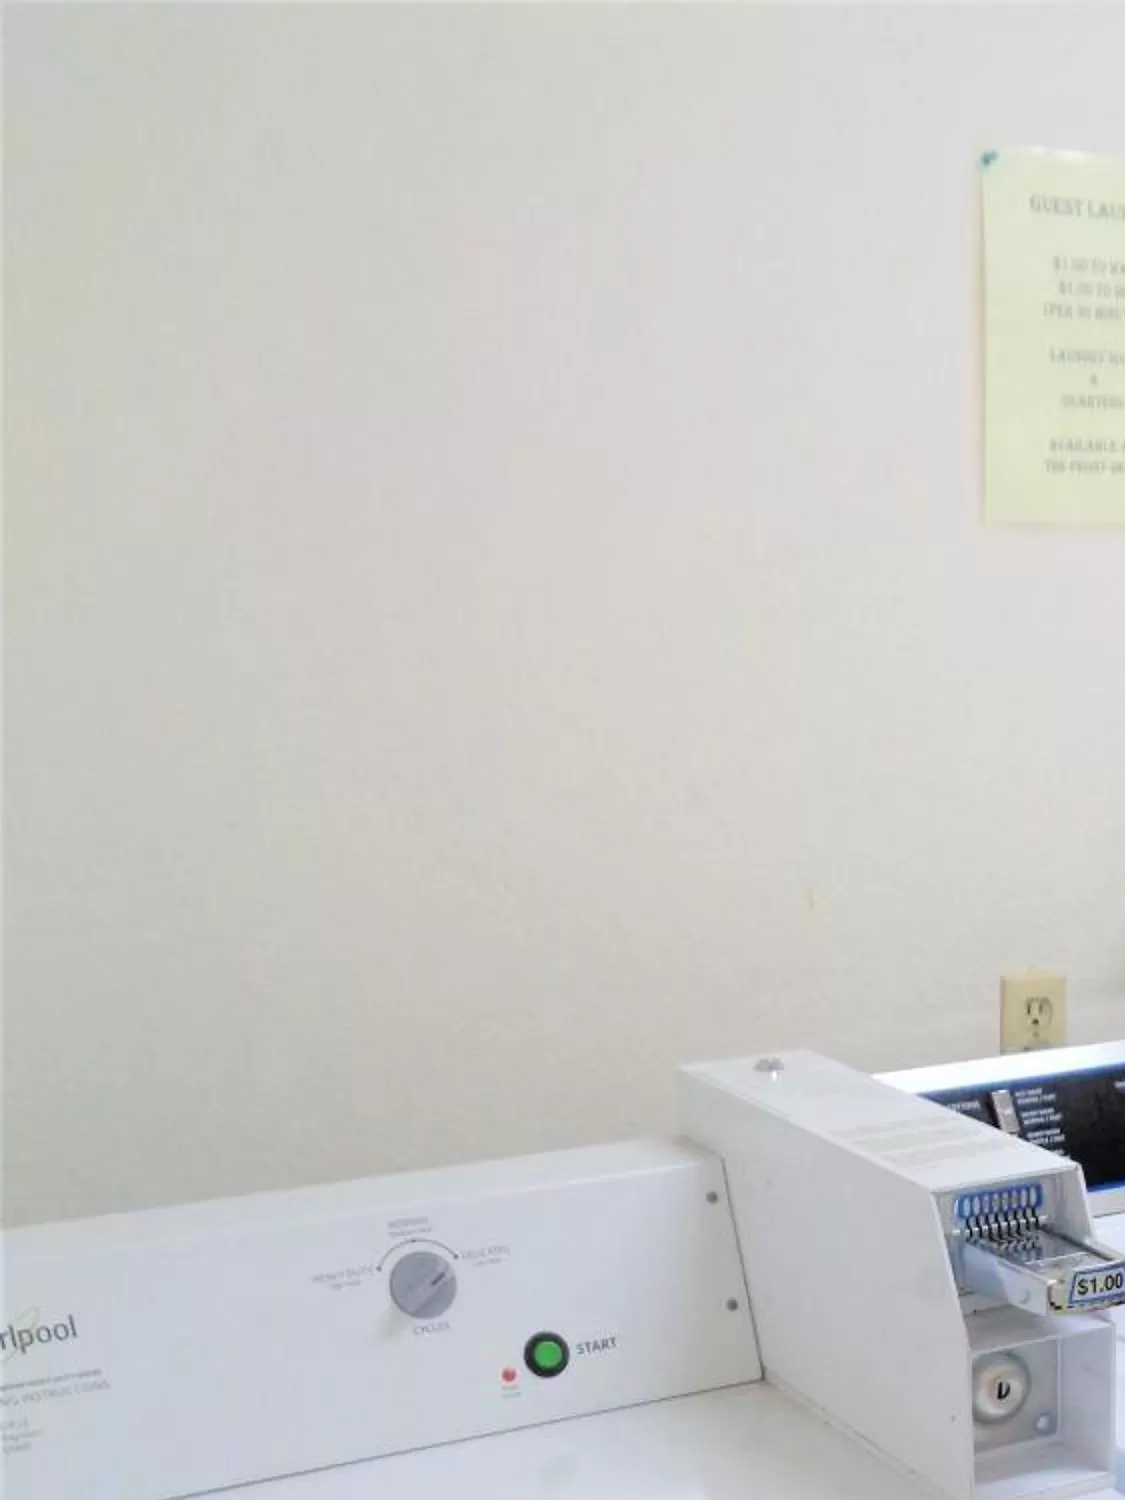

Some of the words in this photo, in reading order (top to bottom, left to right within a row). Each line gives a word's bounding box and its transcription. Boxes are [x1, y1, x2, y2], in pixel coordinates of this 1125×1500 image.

[1029, 194, 1082, 217] GUEST
[1077, 1272, 1124, 1296] $1.00
[575, 1336, 619, 1356] START
